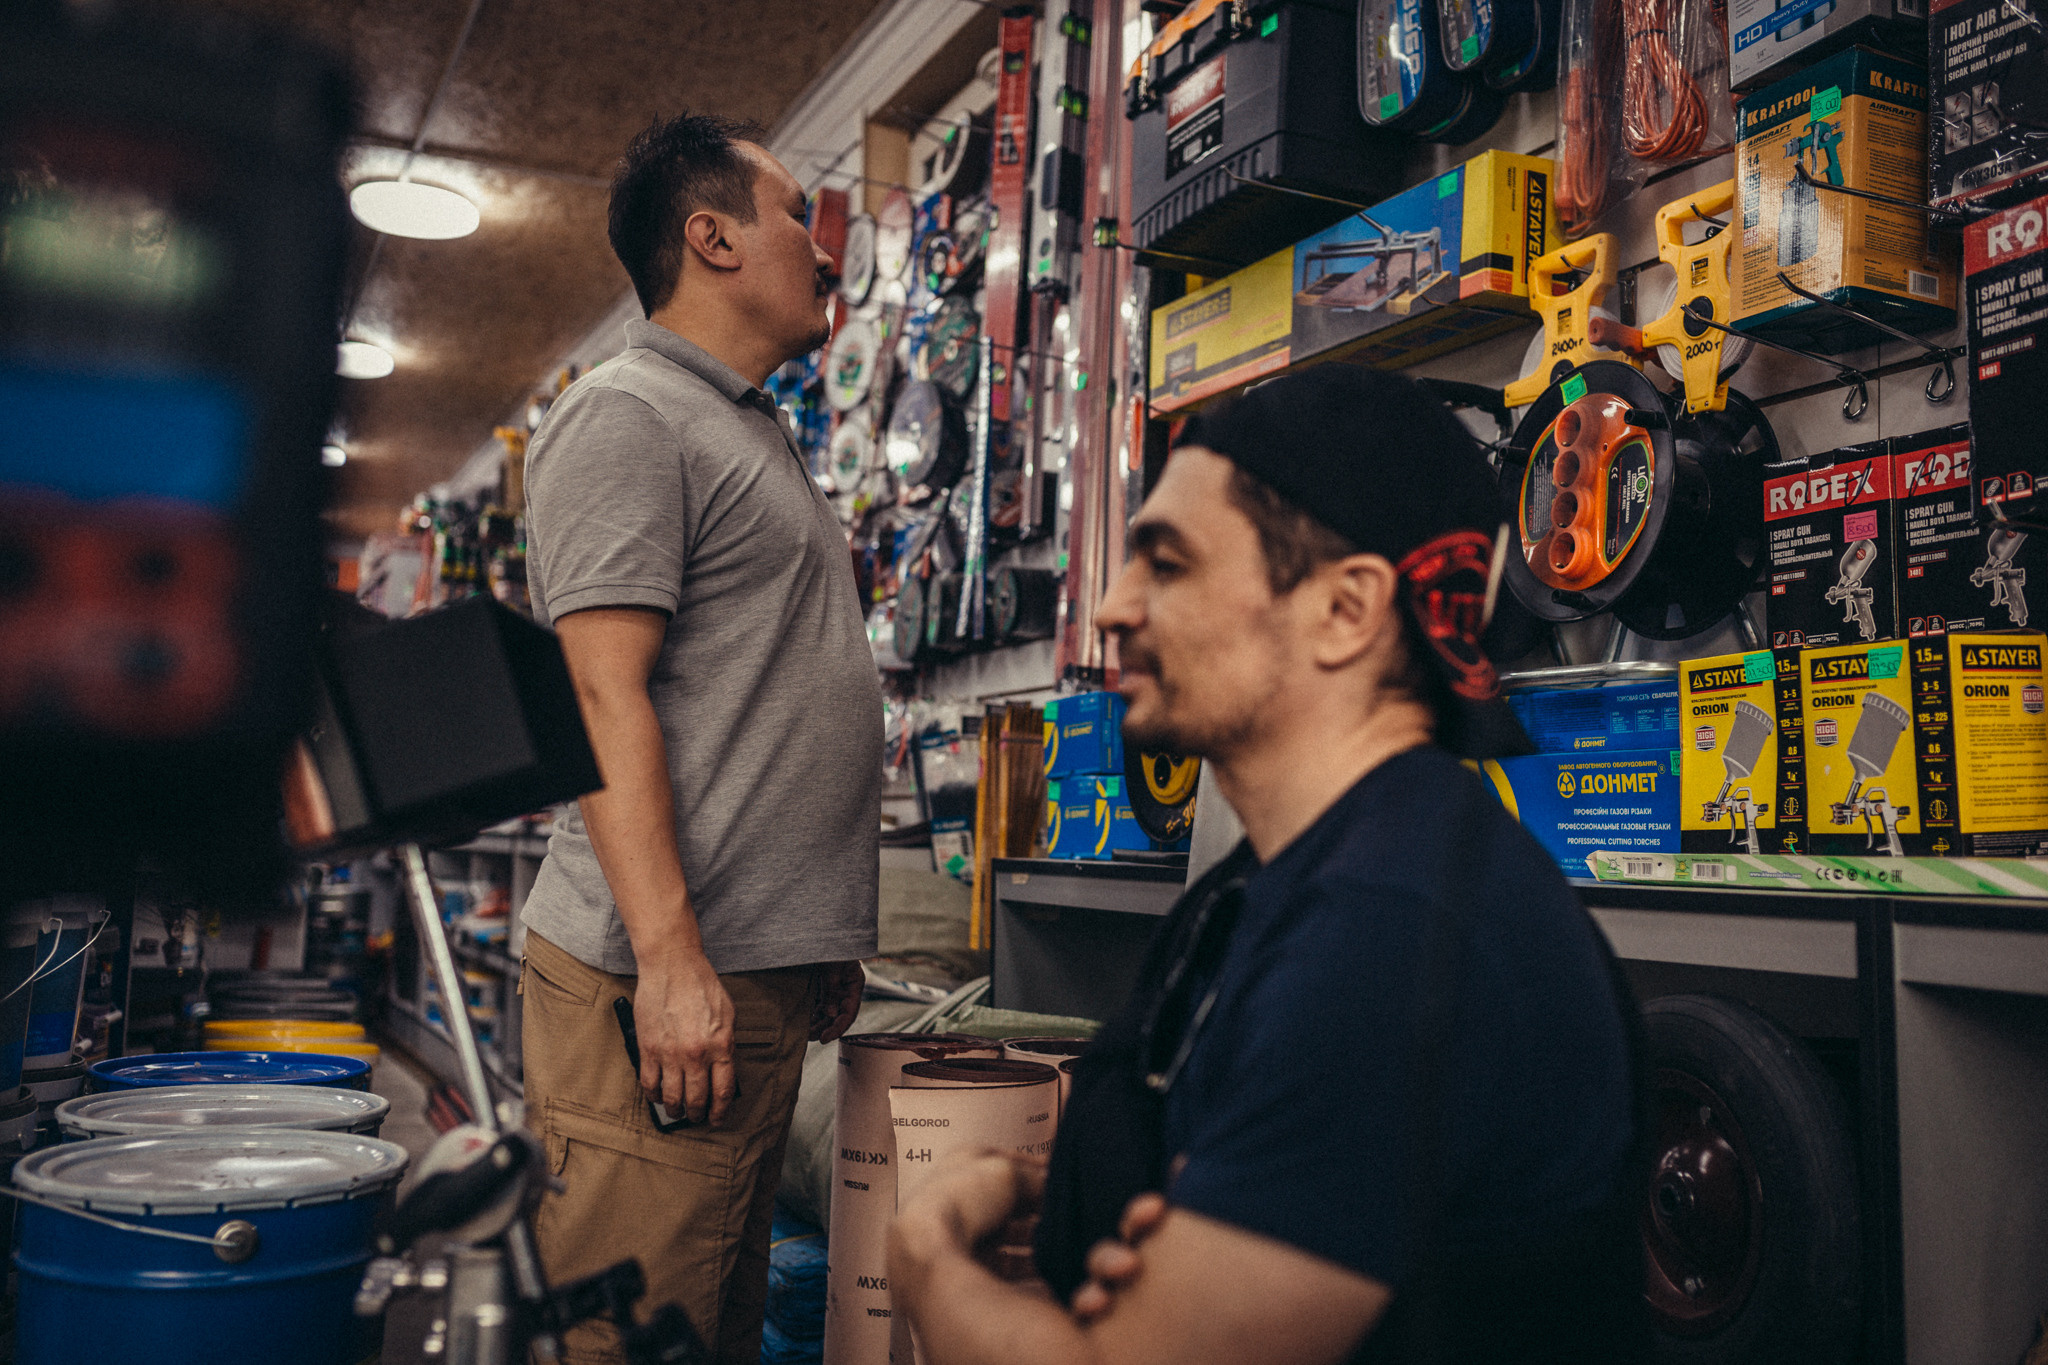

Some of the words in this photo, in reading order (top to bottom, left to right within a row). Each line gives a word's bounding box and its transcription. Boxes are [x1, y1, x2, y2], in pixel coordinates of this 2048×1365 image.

[1771, 9, 1791, 23] Heavy
[1950, 18, 1973, 42] HOT
[1976, 8, 1997, 31] AIR
[1738, 25, 1762, 48] HD
[1948, 34, 1982, 57] ГОРЯЧИЙ
[1948, 44, 1987, 68] ПИСТОЛЕТ
[1948, 66, 1969, 81] SICAK
[1970, 59, 1988, 73] HAVA
[1870, 70, 1926, 99] KRAFTO
[1746, 86, 1816, 127] KRAFTOOL
[1870, 102, 1917, 118] AIRKRAFT
[1747, 123, 1792, 146] AIRKRAFT
[1981, 276, 2016, 301] SPRAY
[2020, 267, 2043, 288] GUN
[1686, 340, 1713, 360] 2000
[1905, 450, 1971, 489] ROD
[1770, 467, 1875, 513] RODEX
[1909, 504, 1935, 519] SPRAY
[1937, 501, 1954, 514] GUN
[1946, 511, 1972, 523] TABANCA
[1773, 527, 1795, 541] SPRAY
[1796, 524, 1811, 536] GUN
[1915, 648, 1932, 663] 1,5
[1978, 648, 2039, 666] STAYER
[1776, 659, 1790, 673] 1,5
[1828, 658, 1869, 677] STAY
[1704, 668, 1746, 687] STAYE
[1964, 684, 2010, 697] ORION
[2023, 691, 2042, 701] HIGH
[1812, 694, 1855, 708] ORION
[1693, 703, 1729, 716] ORION
[1697, 731, 1715, 740] HIGH
[1816, 725, 1836, 734] HIGH
[1581, 740, 1606, 748] ДОНМЕТ
[1576, 762, 1611, 770] АВТОГЕННОГО
[1612, 760, 1657, 769] ОБОРУДОВАНИЯ
[1580, 772, 1658, 794] ДОНМЕТ
[1574, 807, 1609, 816] ПРОФЕСІЙНІ
[1557, 823, 1620, 831] ПРОФЕССИОНАЛЬНЫЕ
[1567, 837, 1607, 845] PROFESSIONAL
[1608, 838, 1632, 846] CUTTING
[1634, 838, 1661, 846] TORCHES
[893, 1118, 950, 1127] BELGOROD
[1027, 1112, 1049, 1124] RUSSIA
[906, 1149, 931, 1162] 4-H
[857, 1276, 887, 1290] 9XW
[867, 1308, 891, 1318] SSIA
